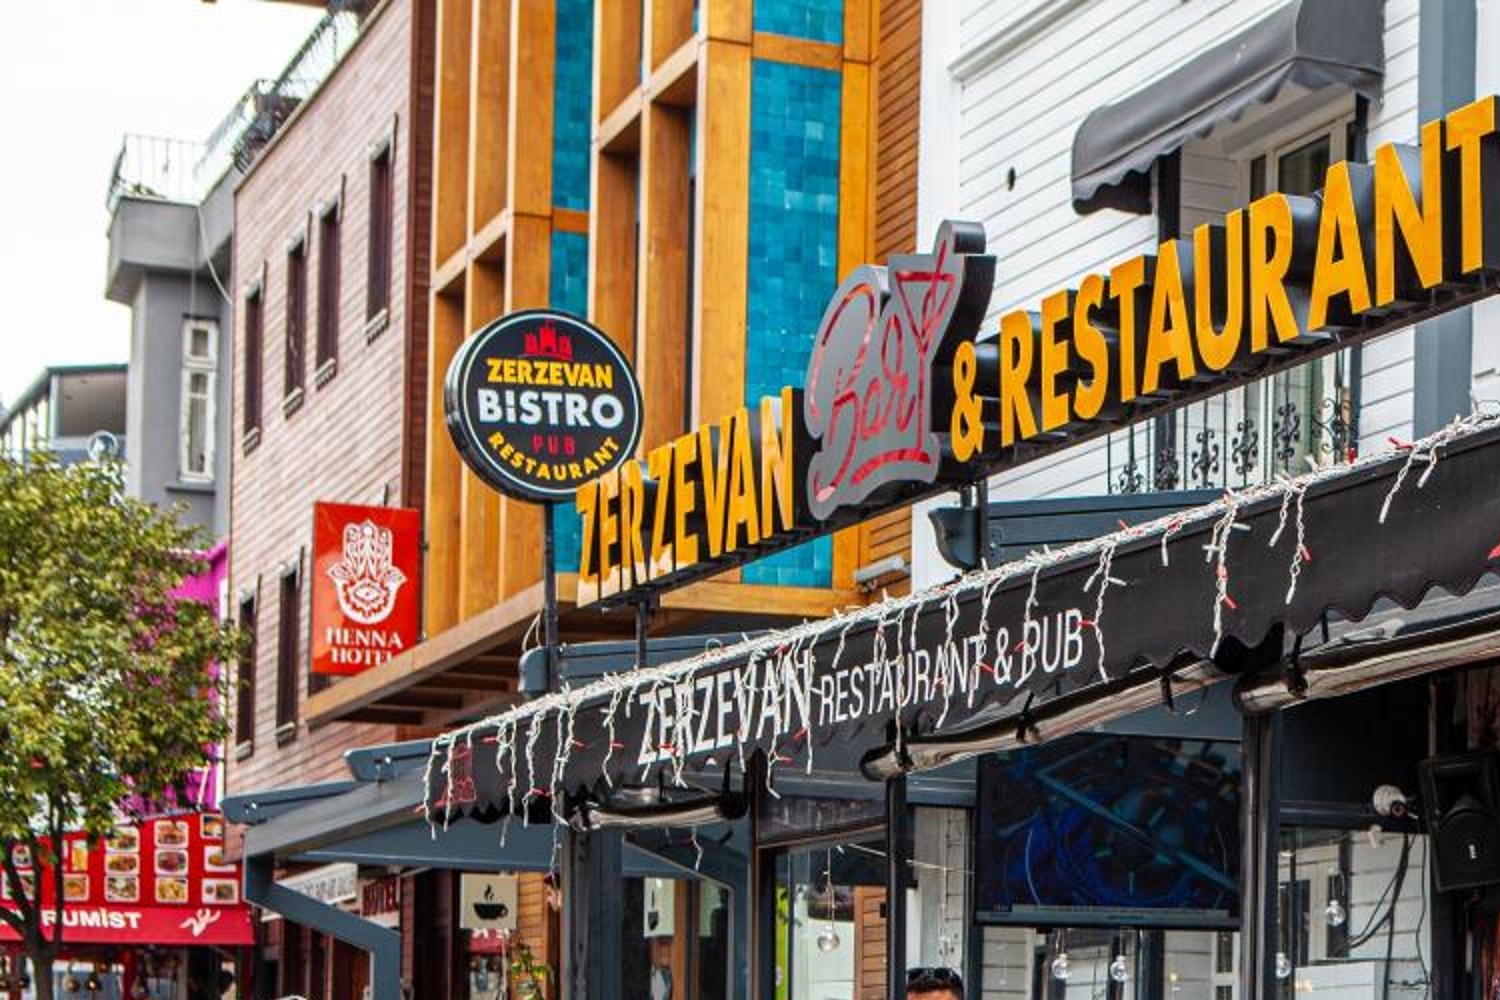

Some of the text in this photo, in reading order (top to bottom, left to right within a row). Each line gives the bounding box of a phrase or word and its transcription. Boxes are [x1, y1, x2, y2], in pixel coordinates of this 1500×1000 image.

[576, 385, 794, 609] ZERZEVAN
[951, 340, 983, 462] &
[1000, 94, 1496, 448] RESTAURANT
[487, 357, 614, 389] ZERZEVAN
[488, 431, 620, 481] RESTAURANT
[533, 434, 576, 457] PUB
[326, 626, 404, 650] HENNA
[637, 608, 1083, 767] ZERZEVAN RESTAURANT & PUB
